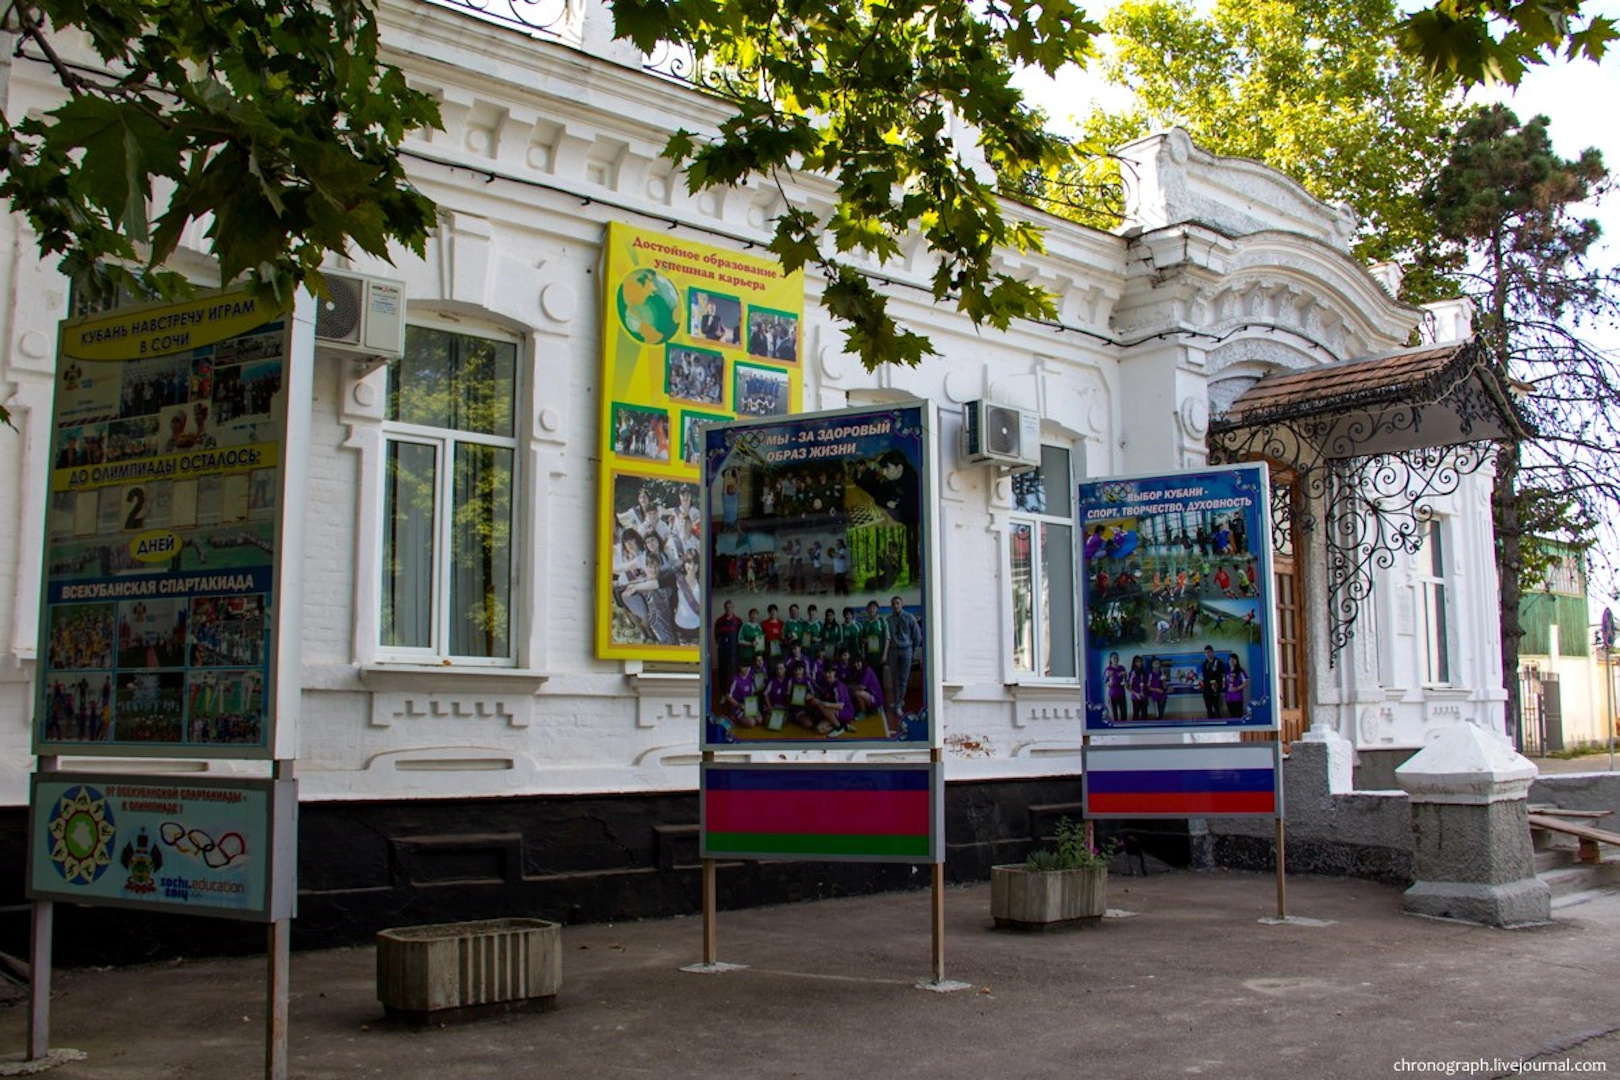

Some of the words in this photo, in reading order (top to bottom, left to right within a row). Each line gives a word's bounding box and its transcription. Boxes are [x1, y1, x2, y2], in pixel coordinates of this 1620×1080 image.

[632, 236, 700, 262] Достойное
[703, 253, 777, 279] образование
[654, 258, 715, 280] успешная
[718, 273, 766, 291] карьера
[81, 326, 128, 346] КУБАНЬ
[132, 309, 203, 335] НАВСТРЕЧУ
[208, 299, 255, 323] ИГРАМ
[139, 341, 147, 353] В
[151, 334, 190, 351] СОЧИ
[765, 434, 789, 446] МЫ
[798, 431, 815, 442] ЗА
[817, 419, 891, 441] ЗДОРОВЫЙ
[766, 449, 807, 463] ОБРАЗ
[808, 442, 857, 459] ЖИЗНИ
[68, 469, 88, 487] ДО
[91, 459, 176, 482] ОЛИМПИАДЫ
[180, 448, 262, 472] ОСТАЛОСЬ:
[1127, 489, 1164, 503] ВЫБОР
[1164, 487, 1203, 500] КУБАНИ
[1186, 497, 1253, 513] ДУХОВНОСТЬ
[125, 488, 145, 530] 2
[137, 533, 176, 556] ДНЕЙ
[61, 577, 157, 600] ВСЕКУБАНСКАЯ
[158, 573, 255, 595] СПАРТАКИАДА
